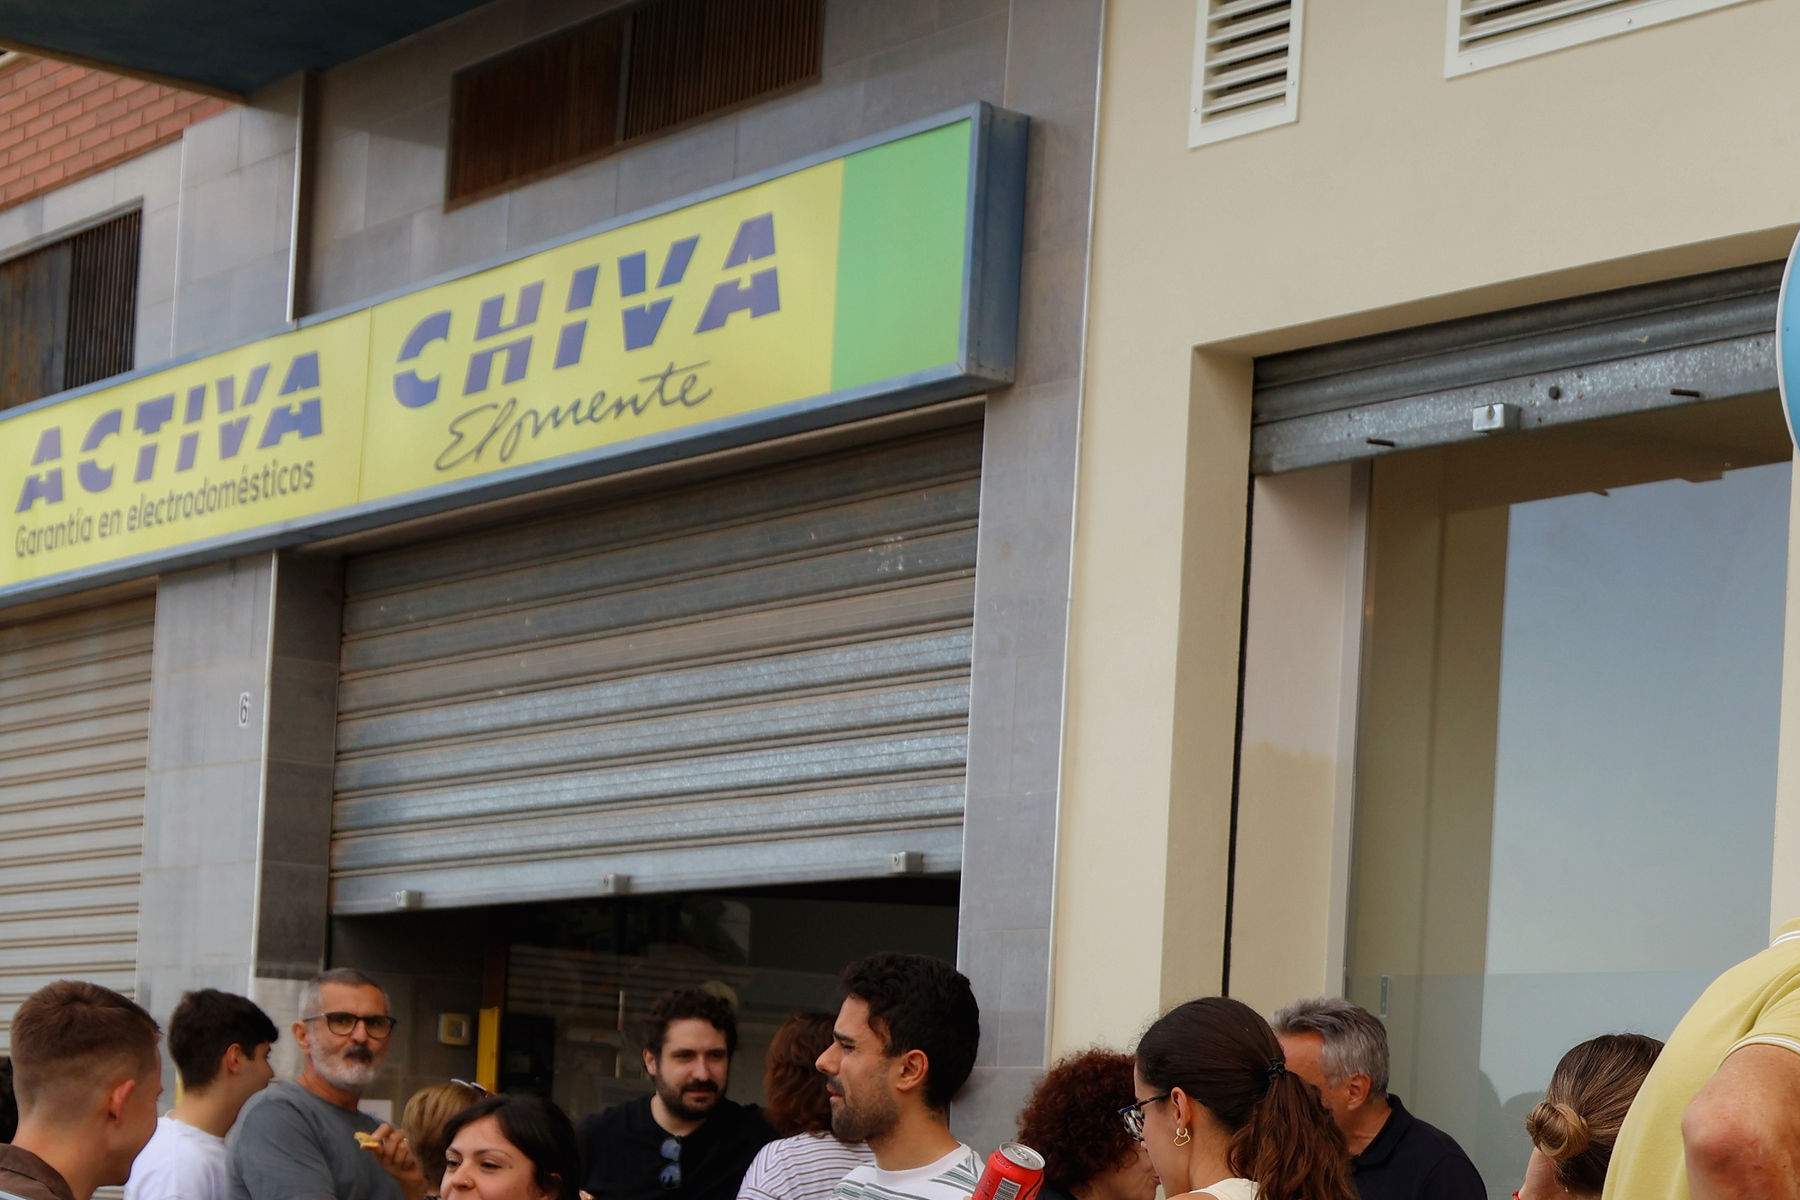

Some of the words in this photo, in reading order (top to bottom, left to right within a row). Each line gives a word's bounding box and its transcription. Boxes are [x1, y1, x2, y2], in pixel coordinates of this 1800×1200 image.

[15, 351, 323, 512] ACTIVA
[393, 212, 780, 408] CHIVA
[16, 508, 92, 557] Garantía
[99, 508, 121, 537] en
[127, 459, 315, 531] electrodomésticos
[240, 693, 248, 725] 6
